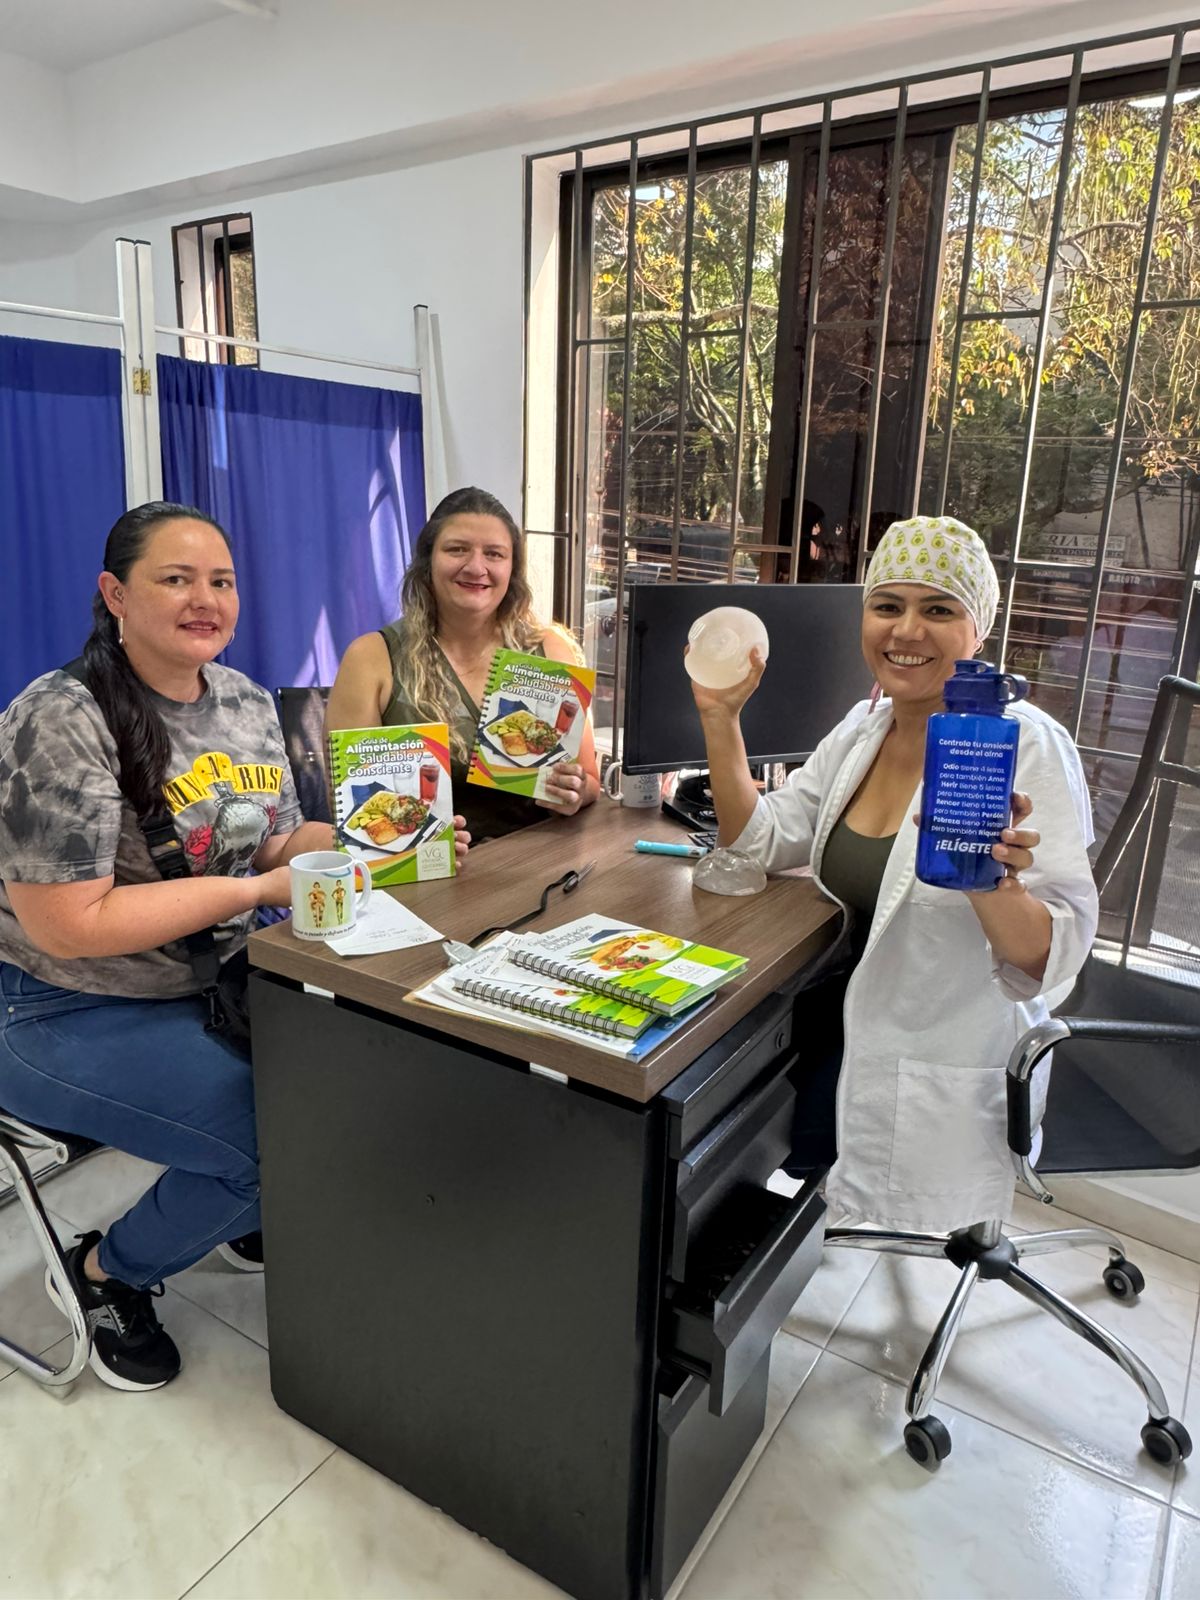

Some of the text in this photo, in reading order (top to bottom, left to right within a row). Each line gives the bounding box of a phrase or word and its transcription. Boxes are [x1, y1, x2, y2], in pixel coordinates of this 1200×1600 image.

[504, 664, 571, 686] Alimentación
[513, 674, 560, 694] Saludable
[500, 682, 556, 704] Consciente
[346, 739, 424, 754] Alimentación
[360, 751, 423, 764] Saludable y
[950, 748, 974, 756] desde
[984, 750, 1004, 758] alma
[347, 763, 412, 777] Consciente
[941, 780, 958, 788] Herir
[953, 791, 984, 800] también
[936, 798, 960, 806] Rencor
[950, 808, 980, 817] también
[933, 816, 960, 824] Pobreza
[946, 826, 978, 836] también
